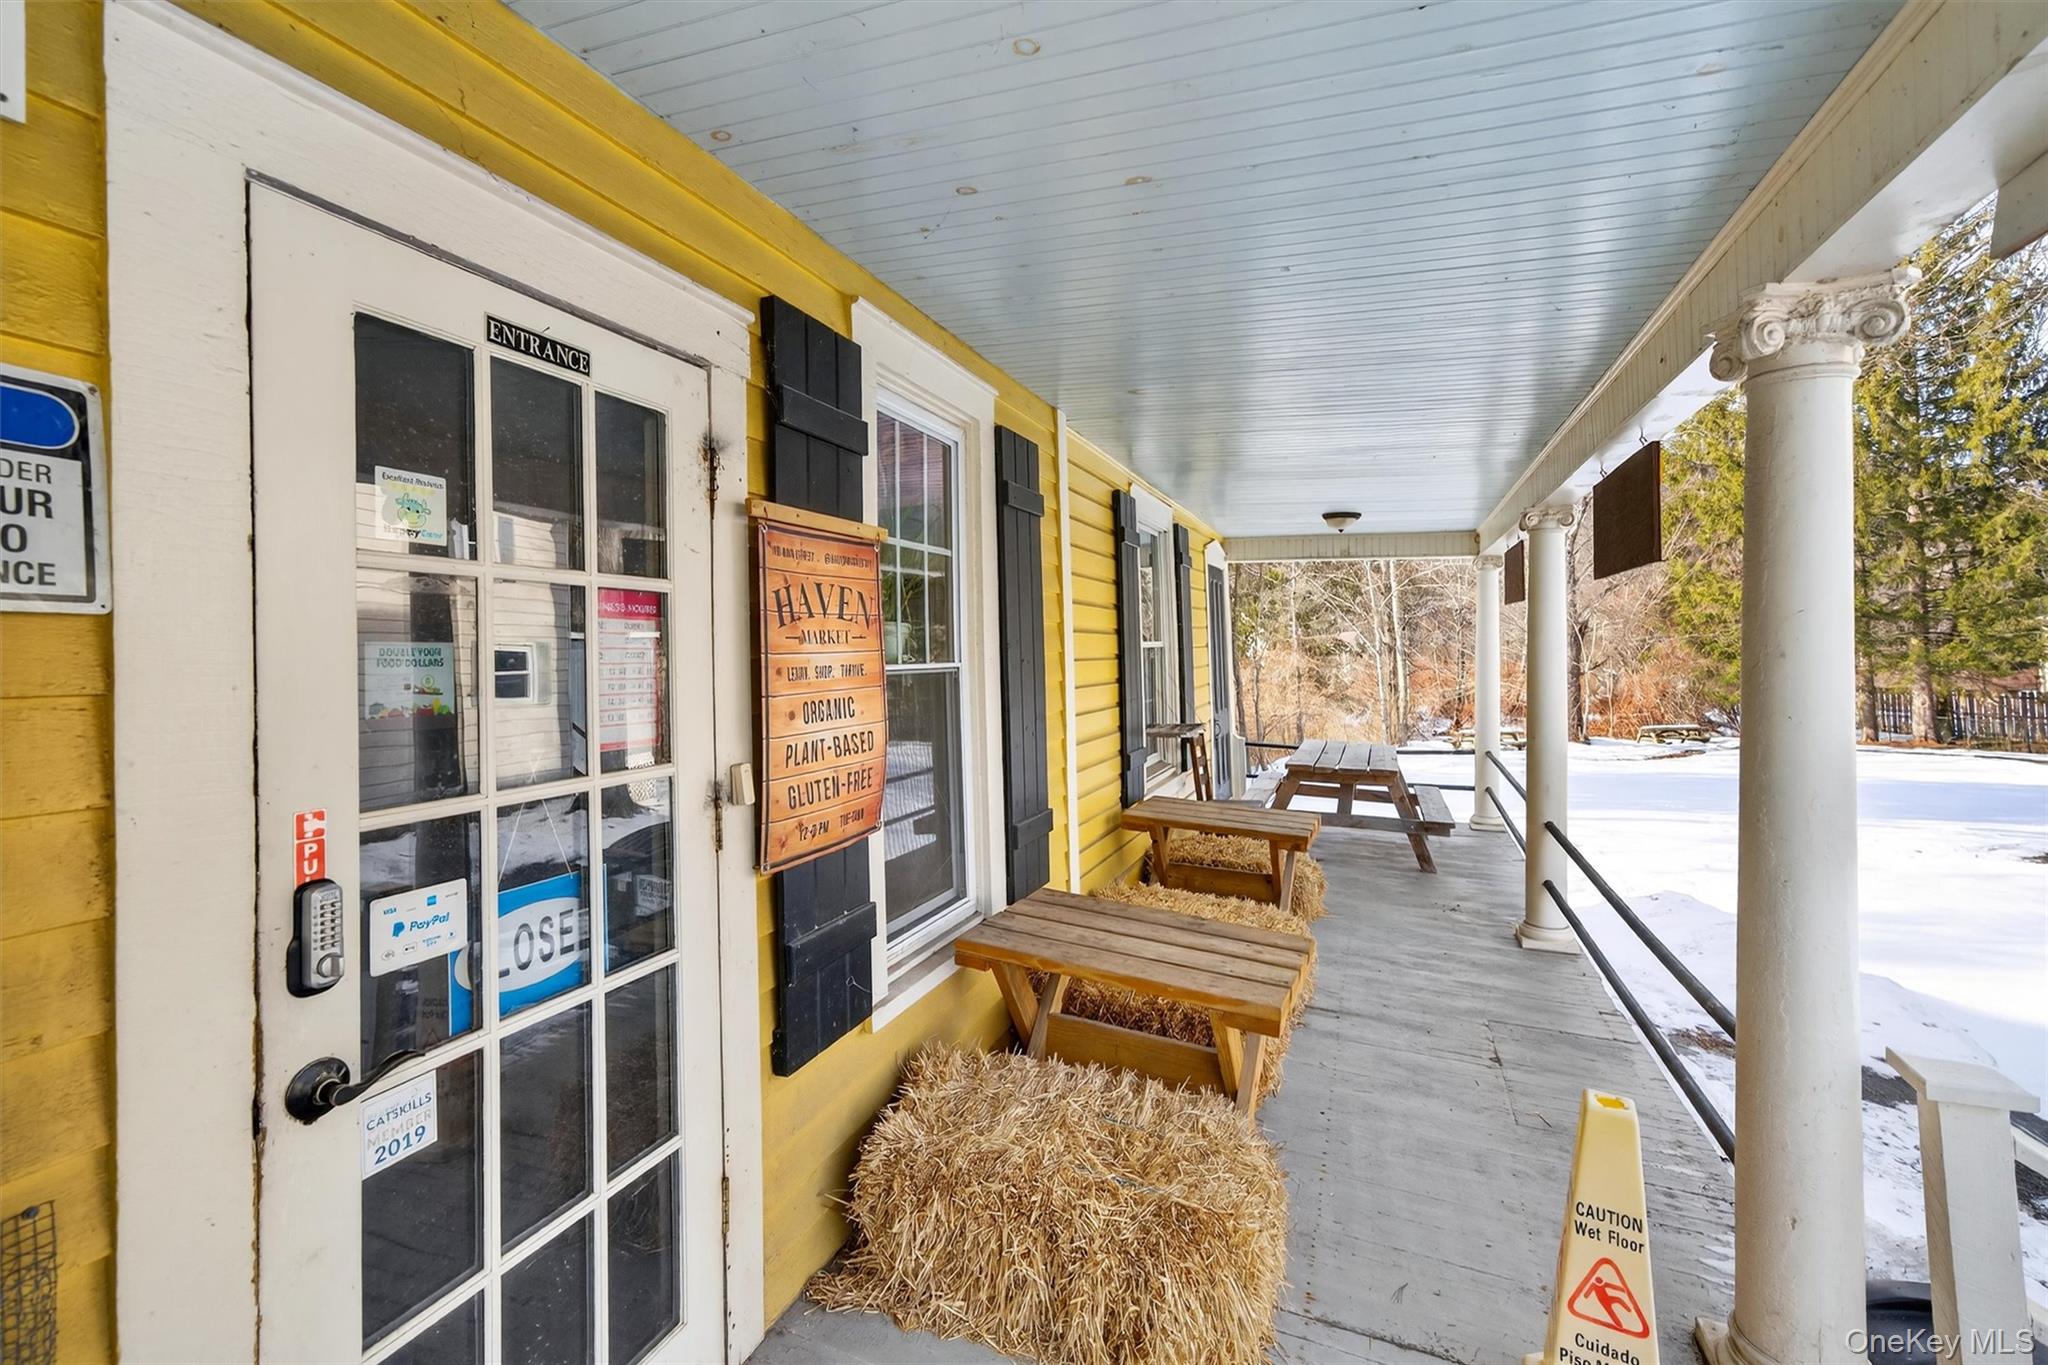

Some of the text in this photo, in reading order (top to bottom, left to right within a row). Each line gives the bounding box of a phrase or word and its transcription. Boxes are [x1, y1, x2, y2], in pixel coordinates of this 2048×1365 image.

[488, 319, 590, 373] ENTRANCE
[771, 581, 874, 630] HAVEN
[379, 647, 442, 657] DOUBLE YOUR
[799, 629, 851, 645] MARKET
[376, 658, 444, 668] FOOD DOLLARS
[802, 696, 856, 725] ORGANIC
[785, 730, 875, 768] PLANT-BASED
[788, 767, 874, 810] GLUTEN-FREE
[303, 842, 319, 882] PU
[409, 911, 451, 932] PayPal
[366, 1092, 432, 1131] CATSKILLS
[374, 1125, 426, 1166] 2019
[1575, 1201, 1643, 1234] CAUTION
[1574, 1220, 1645, 1254] Wet Floor
[1575, 1332, 1640, 1365] Cuidado
